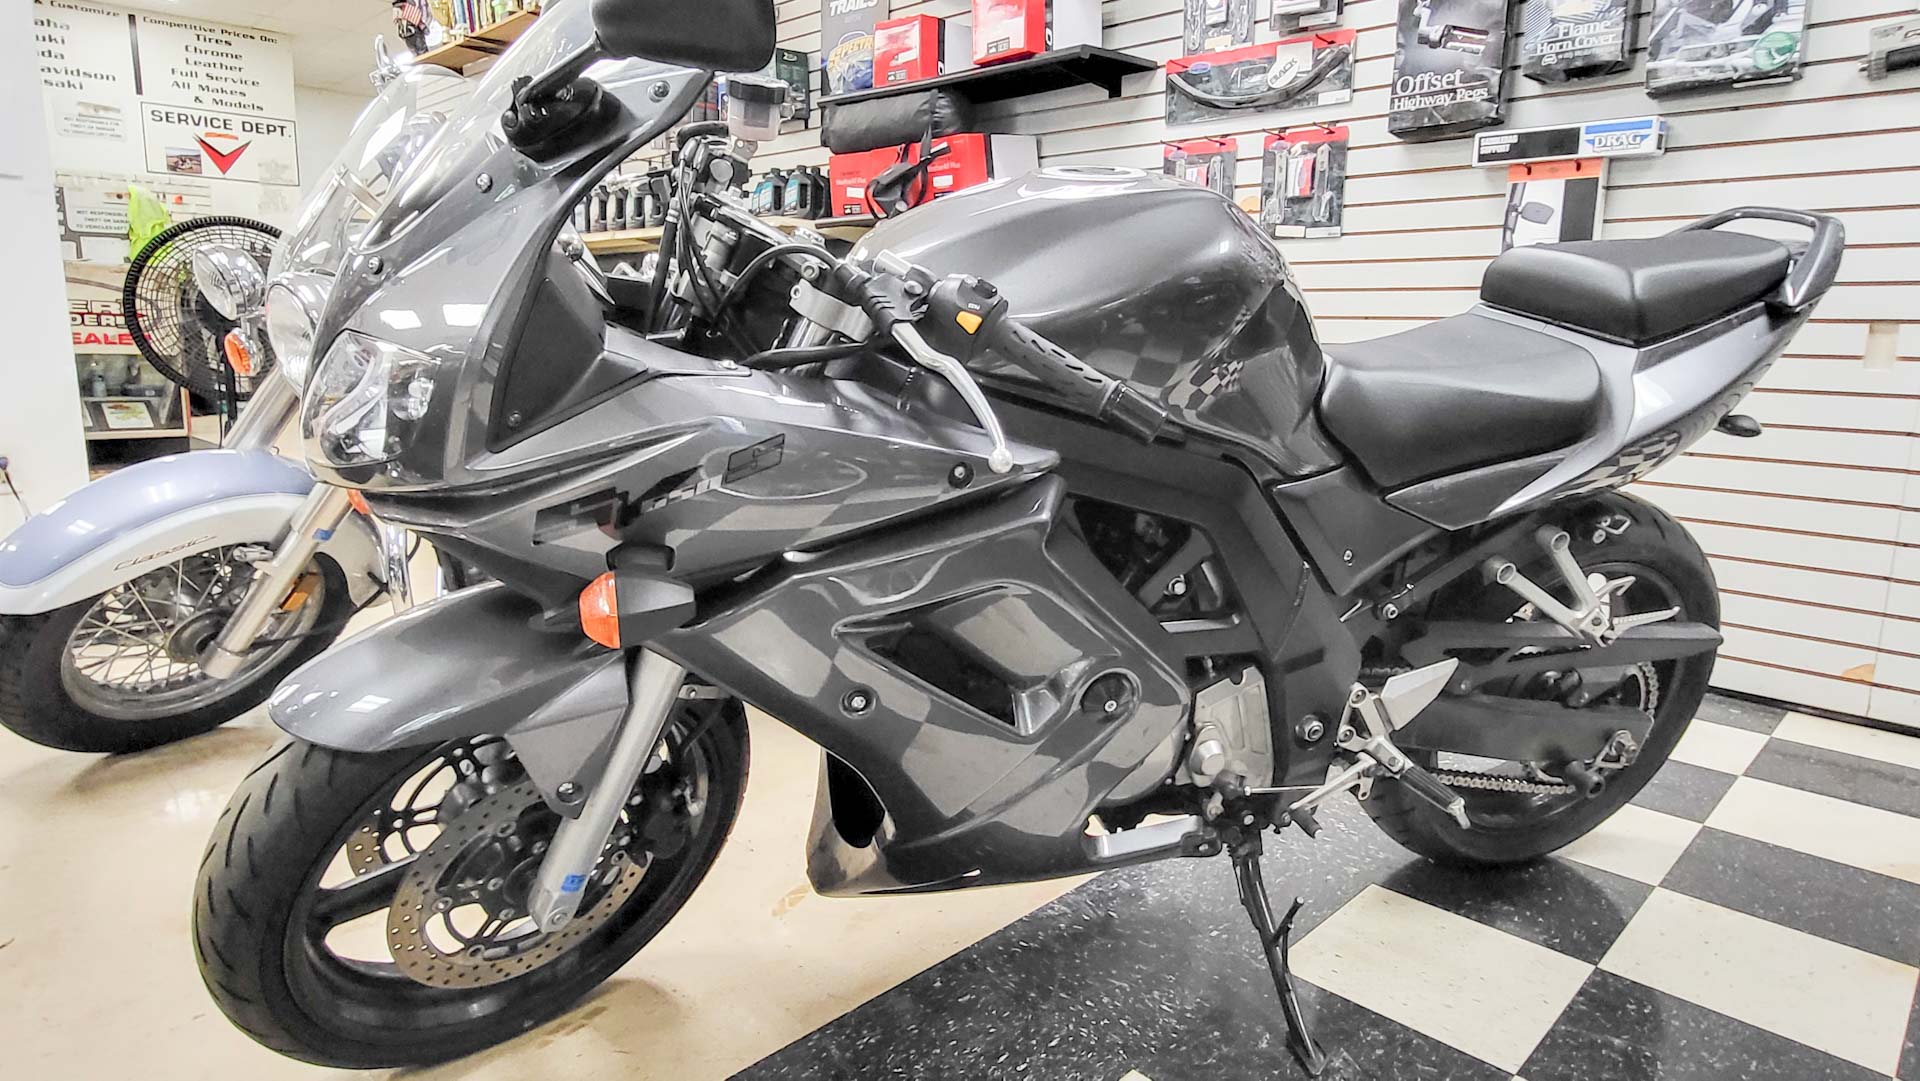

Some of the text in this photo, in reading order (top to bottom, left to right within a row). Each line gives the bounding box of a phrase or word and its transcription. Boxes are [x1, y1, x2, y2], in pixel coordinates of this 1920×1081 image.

[50, 0, 120, 17] Customize
[830, 0, 878, 16] TRAILS
[143, 16, 216, 34] Competitive
[220, 28, 255, 40] Prices
[1559, 20, 1611, 38] Flame
[194, 33, 232, 47] Tires
[1536, 40, 1573, 55] Horn
[1575, 33, 1617, 48] Cover
[37, 49, 65, 60] da
[185, 44, 243, 60] Chrome
[185, 57, 245, 73] Leather
[171, 67, 260, 87] Full Service
[1395, 68, 1465, 96] Offset
[171, 80, 247, 98] All Makes
[194, 95, 264, 112] & Models
[1392, 87, 1488, 111] Highway Pegs
[150, 109, 292, 138] SERVICE DEPT.
[1594, 132, 1641, 148] DRAG
[72, 332, 150, 345] EALE
[113, 536, 216, 571] Classic
